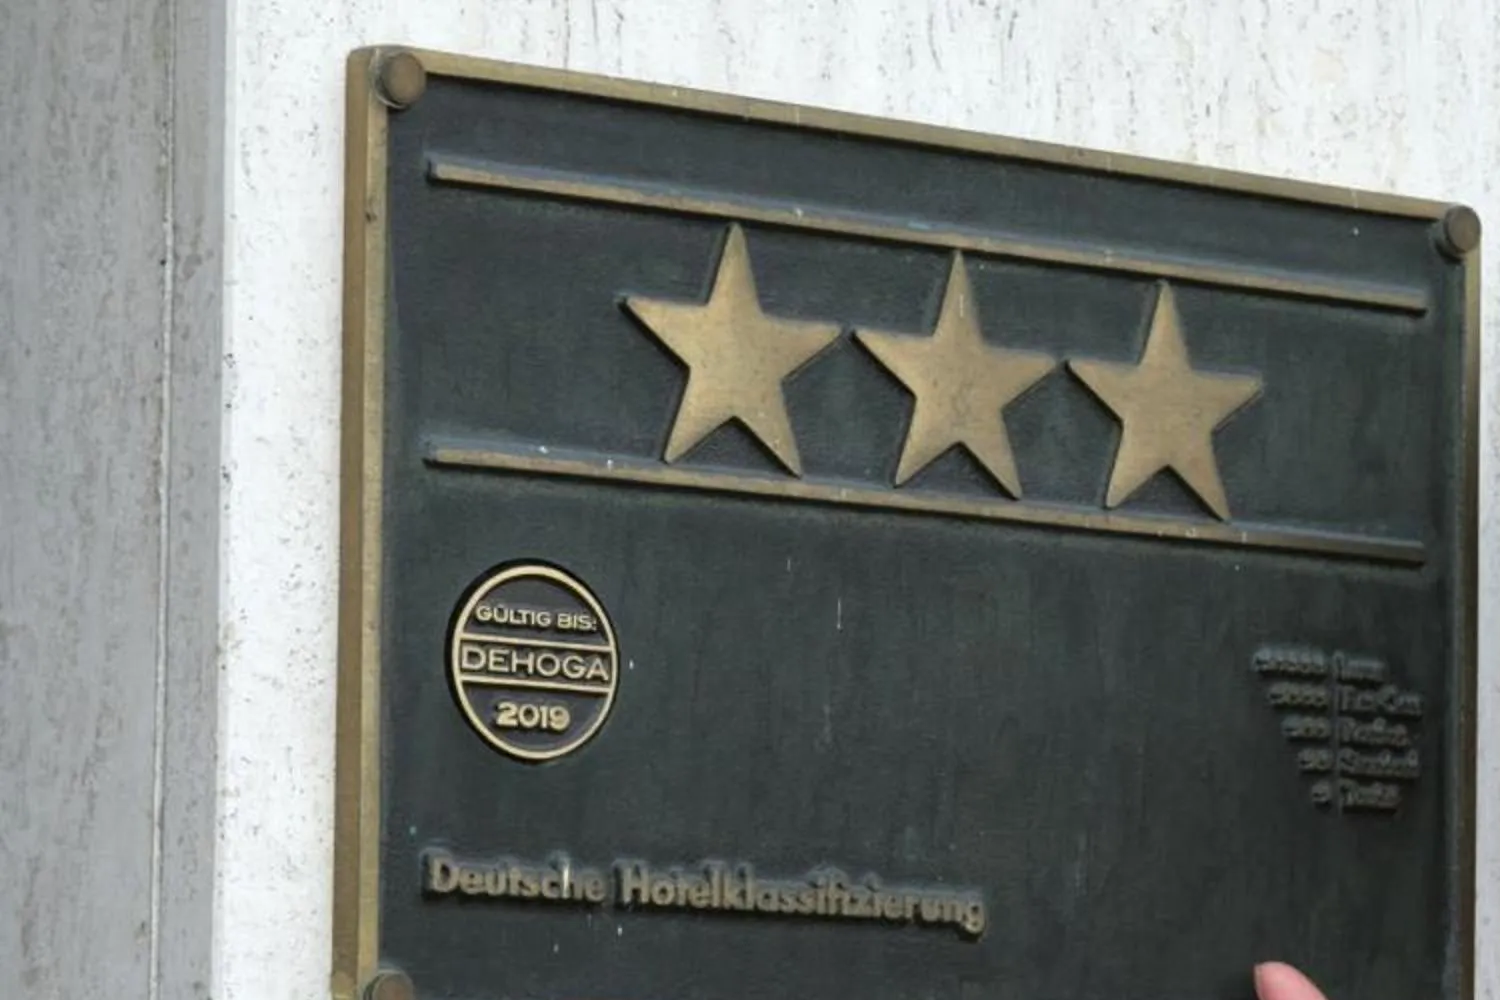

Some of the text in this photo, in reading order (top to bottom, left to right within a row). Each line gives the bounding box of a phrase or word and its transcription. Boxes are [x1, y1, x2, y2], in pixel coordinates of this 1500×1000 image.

[475, 603, 598, 632] GÜLTIG BIS:
[461, 645, 610, 682] DEHOGA
[496, 701, 571, 731] 2019
[427, 853, 987, 935] Deutsche Hotelklassifizierung
